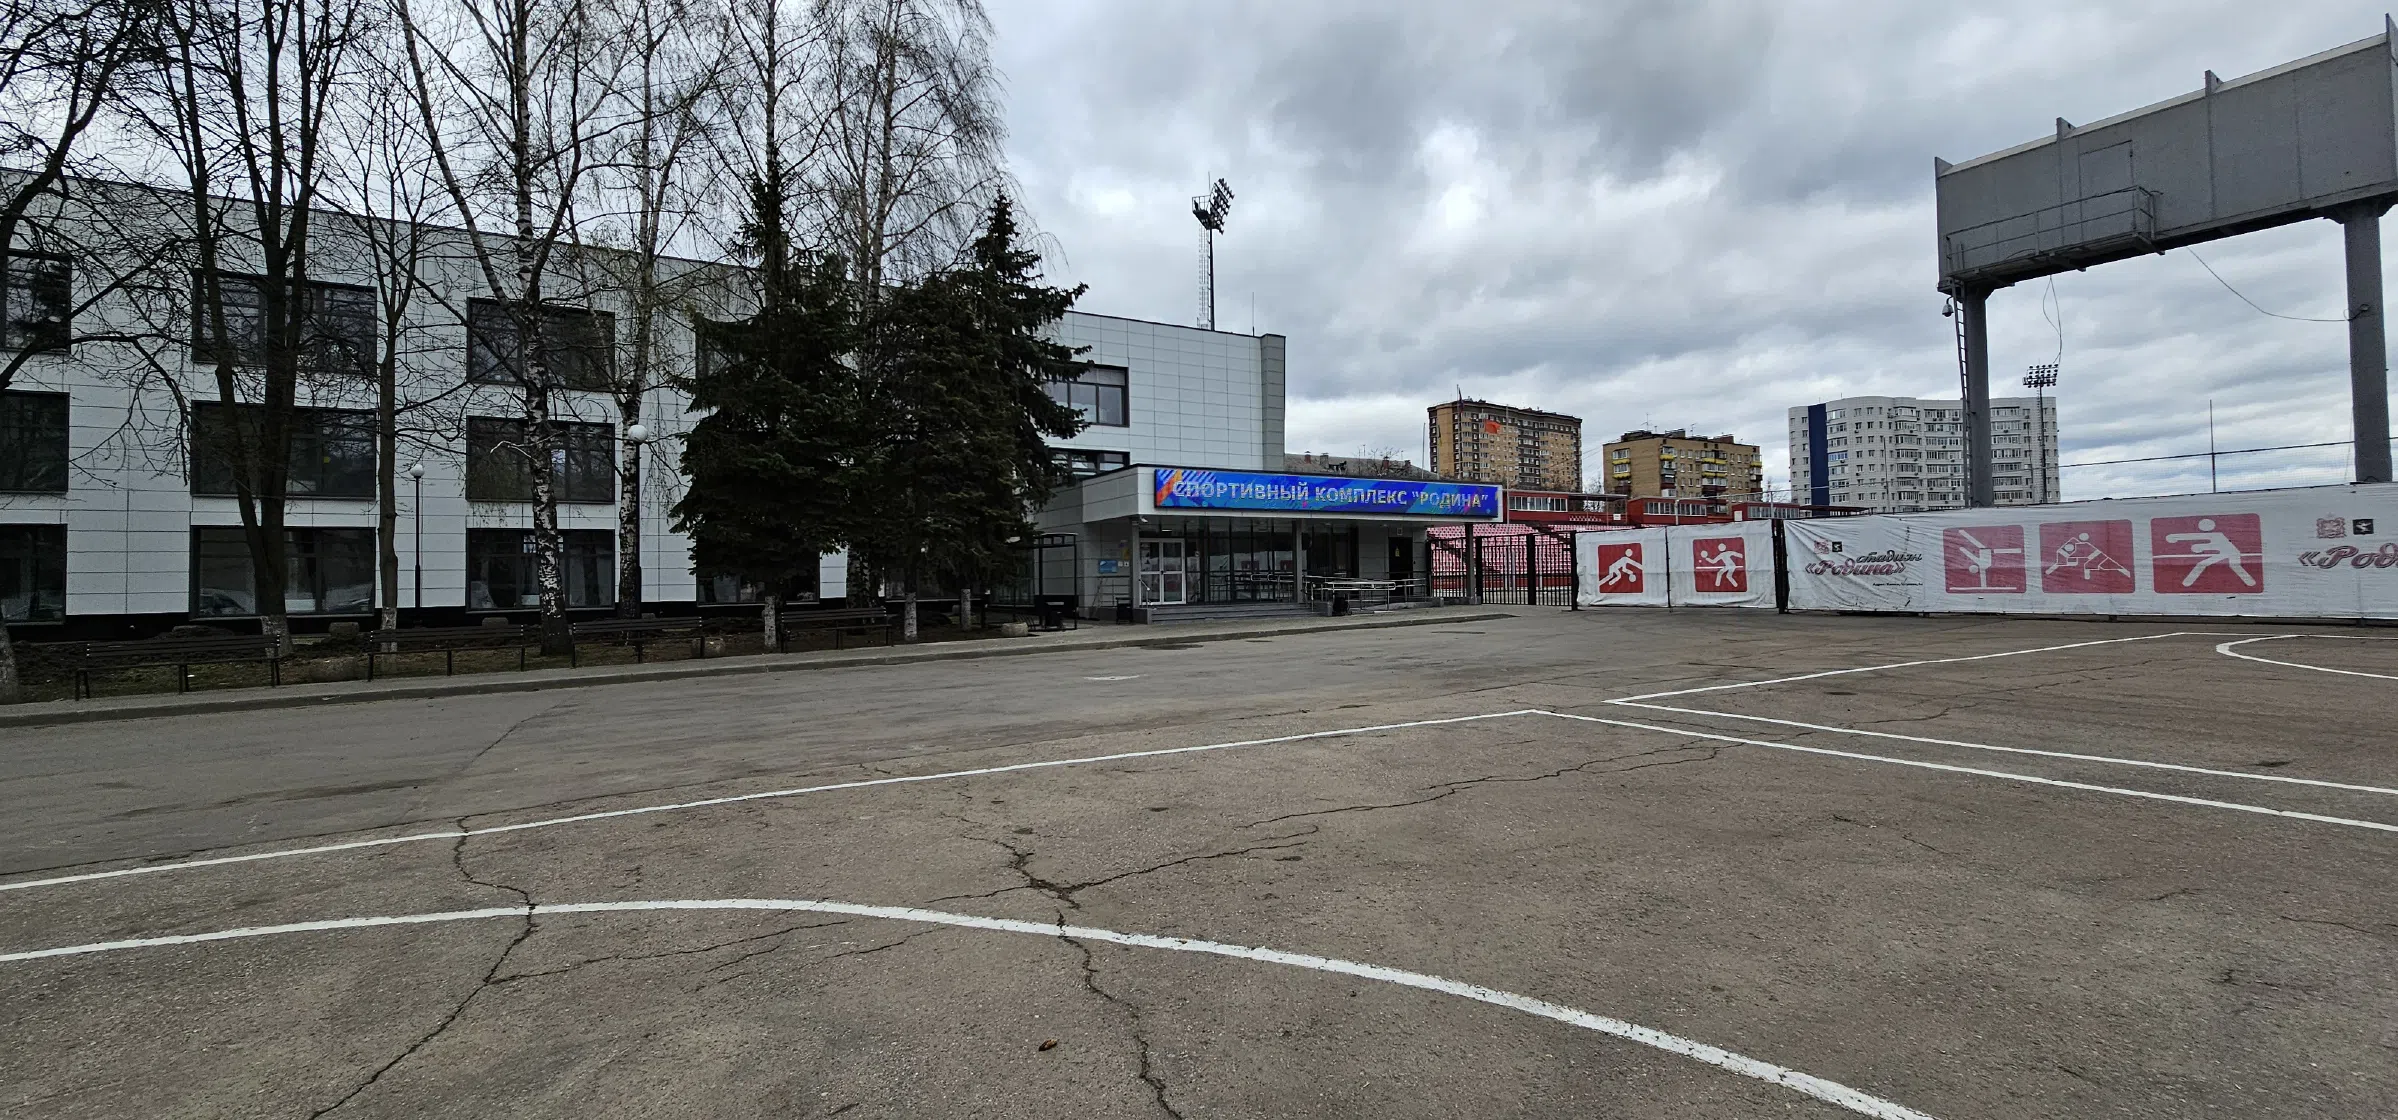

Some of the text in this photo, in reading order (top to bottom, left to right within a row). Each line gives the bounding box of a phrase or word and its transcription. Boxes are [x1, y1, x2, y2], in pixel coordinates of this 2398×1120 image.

[1173, 480, 1488, 508] СПОРТИВНЫЙ КОМПЛЕКС "РОДИНА"
[1805, 558, 1906, 576] «Родина»
[2298, 543, 2398, 569] «Род
